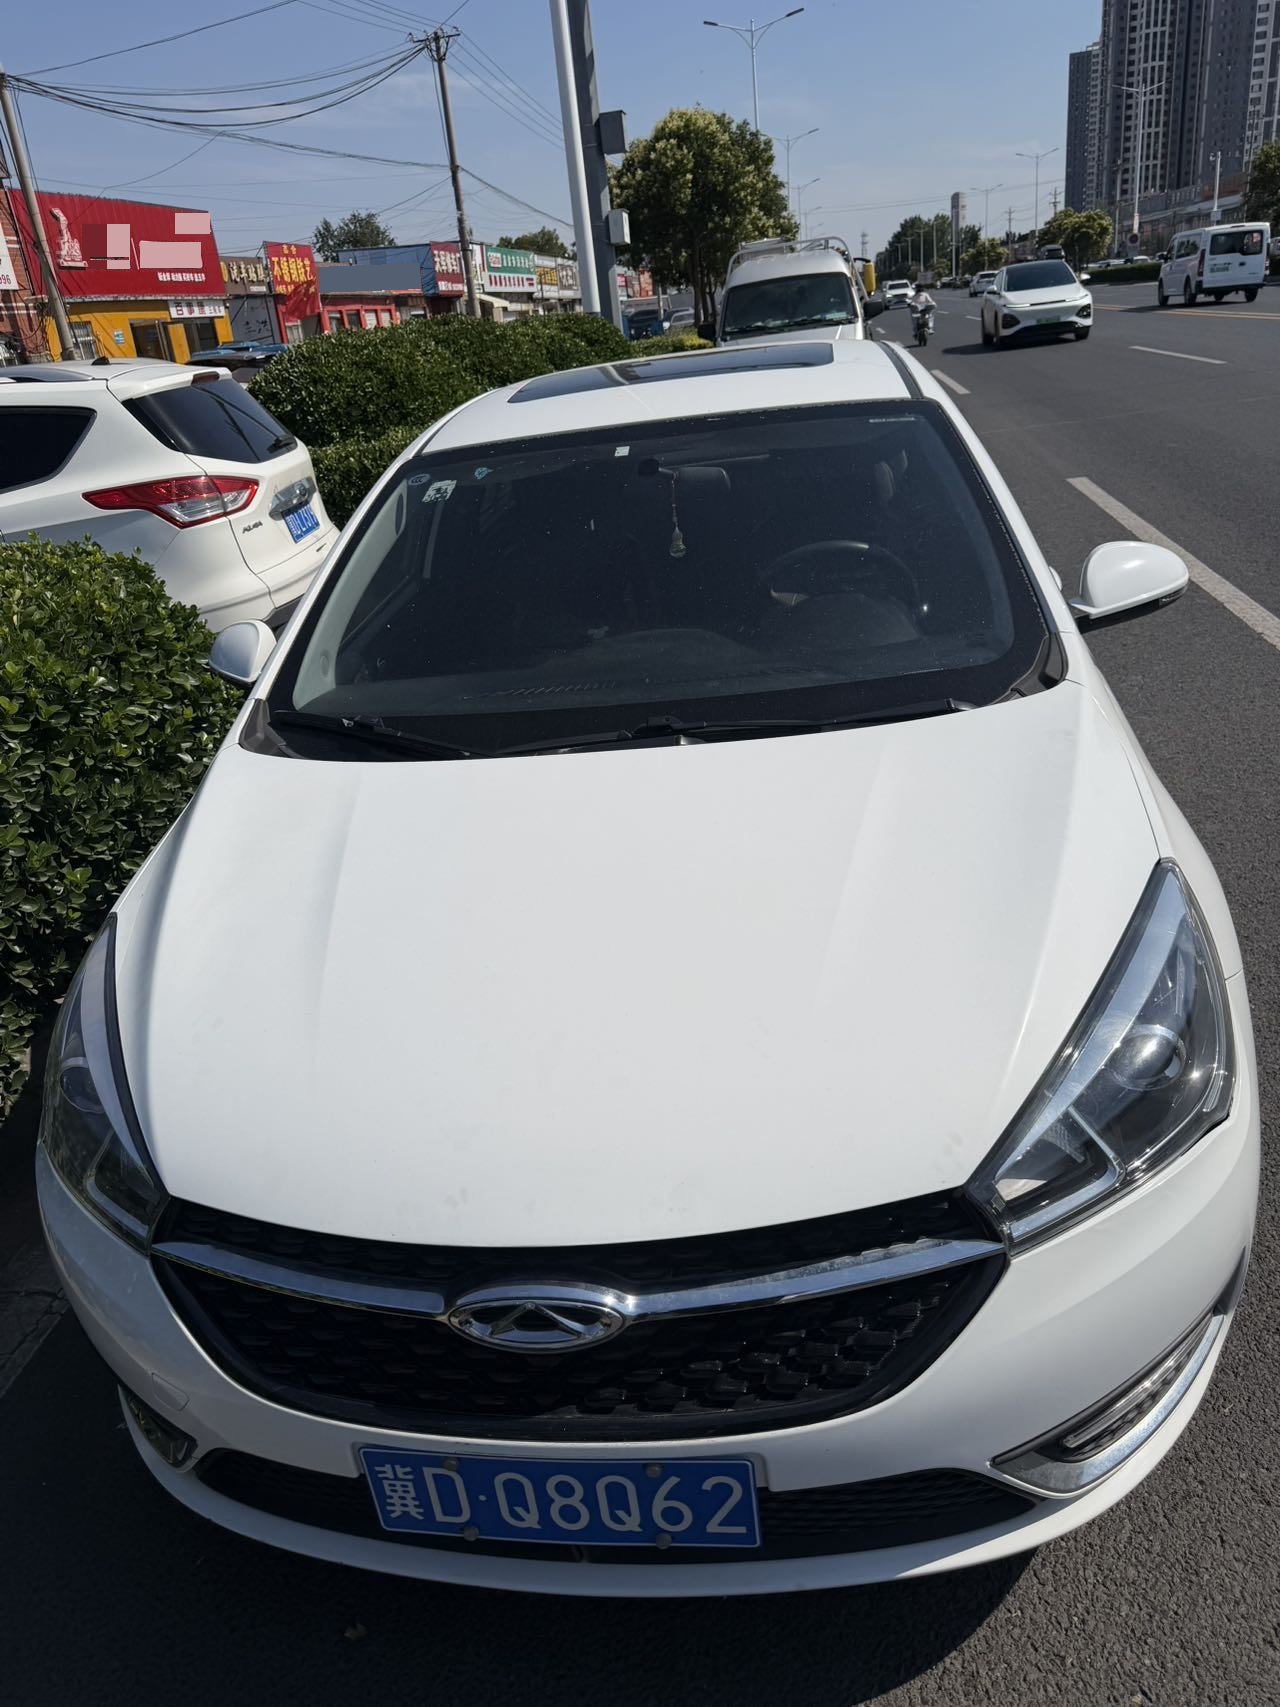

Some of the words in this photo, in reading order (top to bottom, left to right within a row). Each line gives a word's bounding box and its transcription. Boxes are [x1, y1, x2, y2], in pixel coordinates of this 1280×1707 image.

[272, 256, 314, 284] 不锈钢铁艺
[374, 1464, 747, 1534] 冀D·Q8Q62
